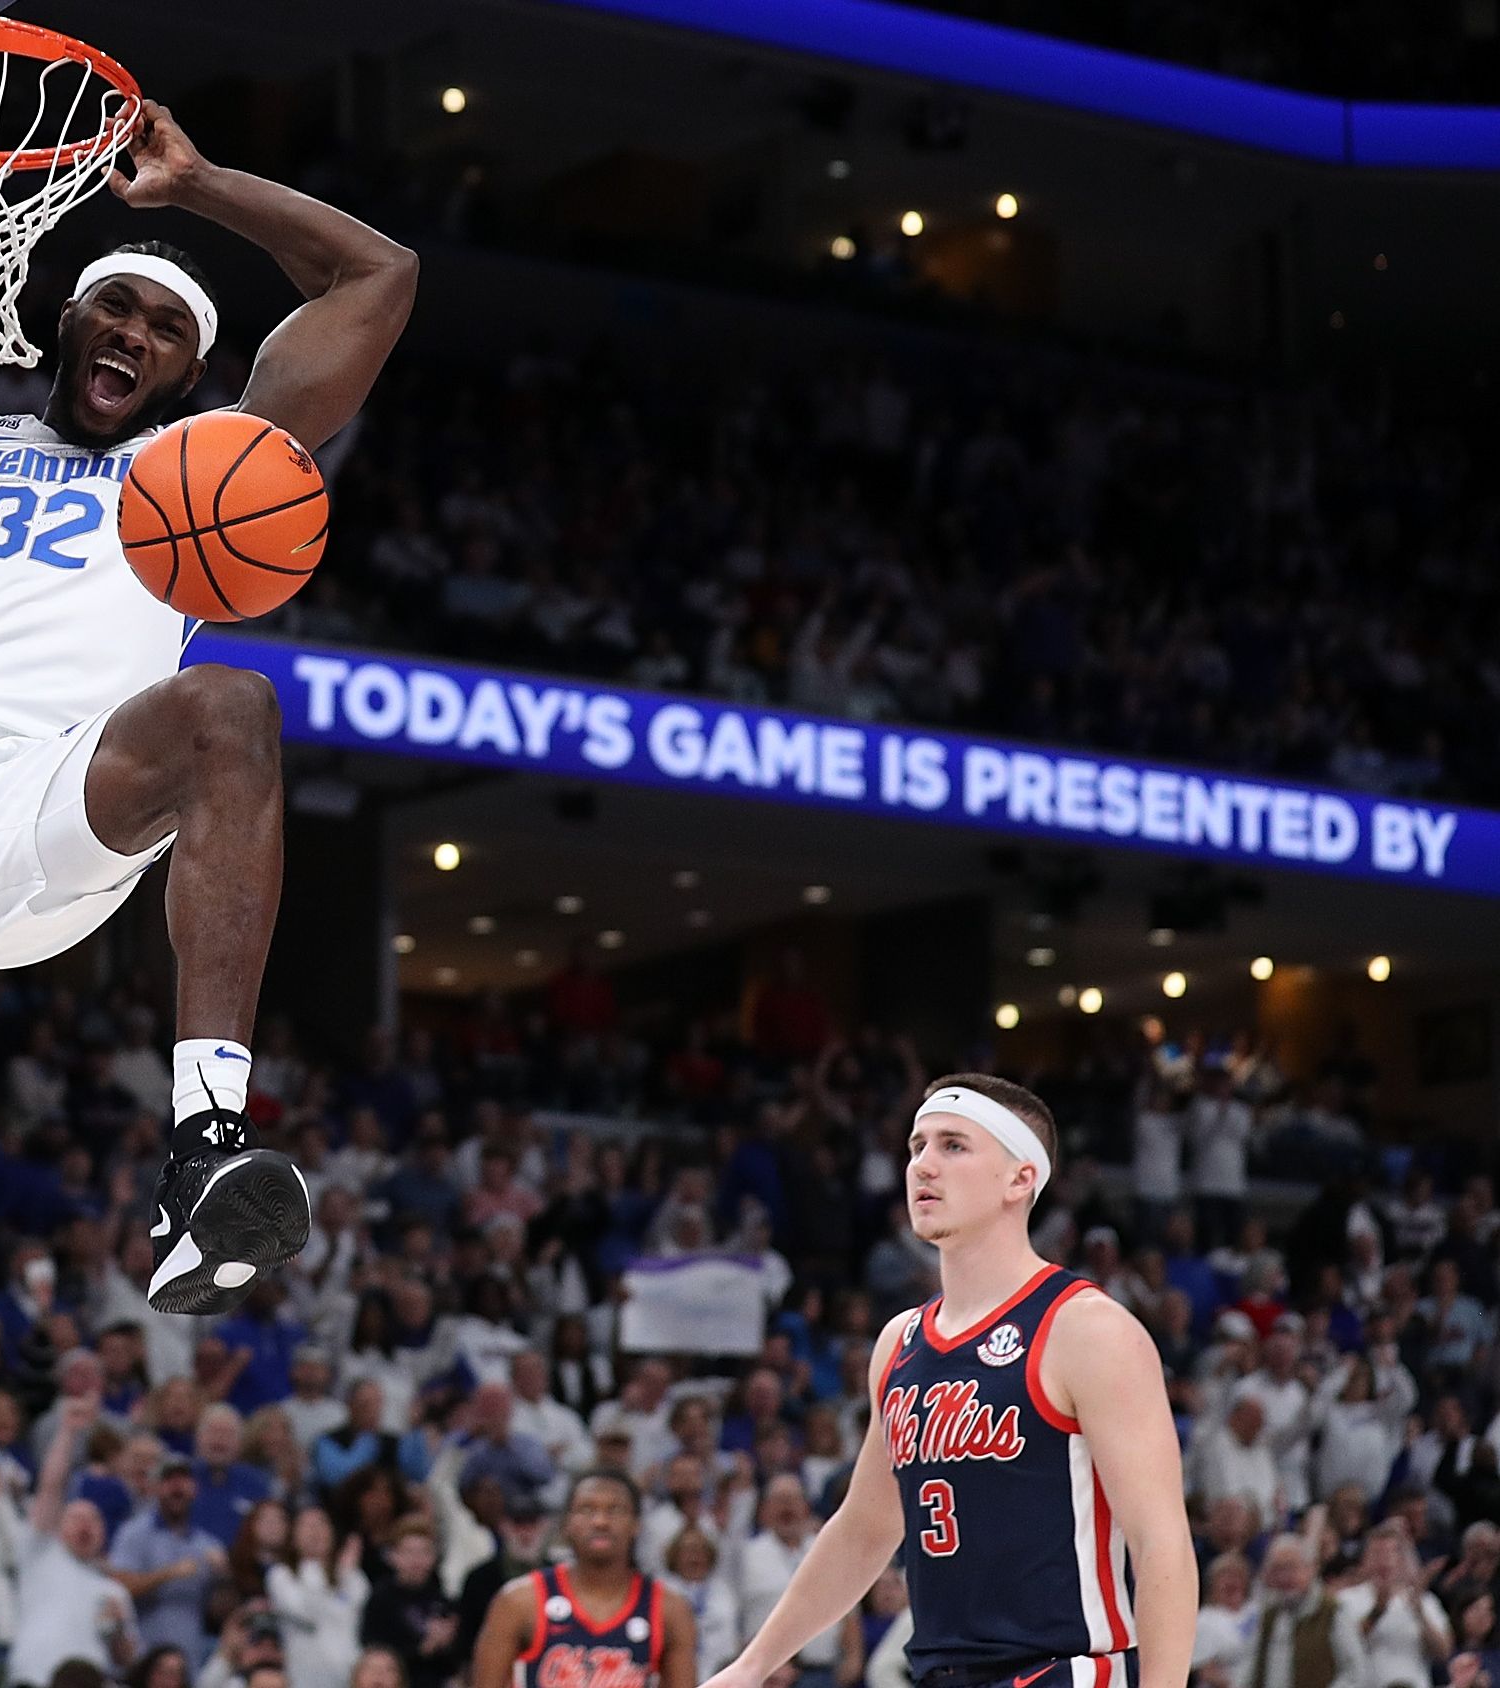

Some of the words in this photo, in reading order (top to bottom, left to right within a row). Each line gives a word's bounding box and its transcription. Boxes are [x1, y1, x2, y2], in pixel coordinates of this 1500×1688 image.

[294, 655, 634, 768] TODAY'S
[647, 704, 867, 799] GAME
[881, 734, 951, 810] IS
[964, 746, 1360, 863] PRESENTED
[1372, 803, 1457, 877] BY
[987, 1324, 1020, 1355] SEC
[919, 1379, 1026, 1462] Miss
[919, 1478, 961, 1557] 3
